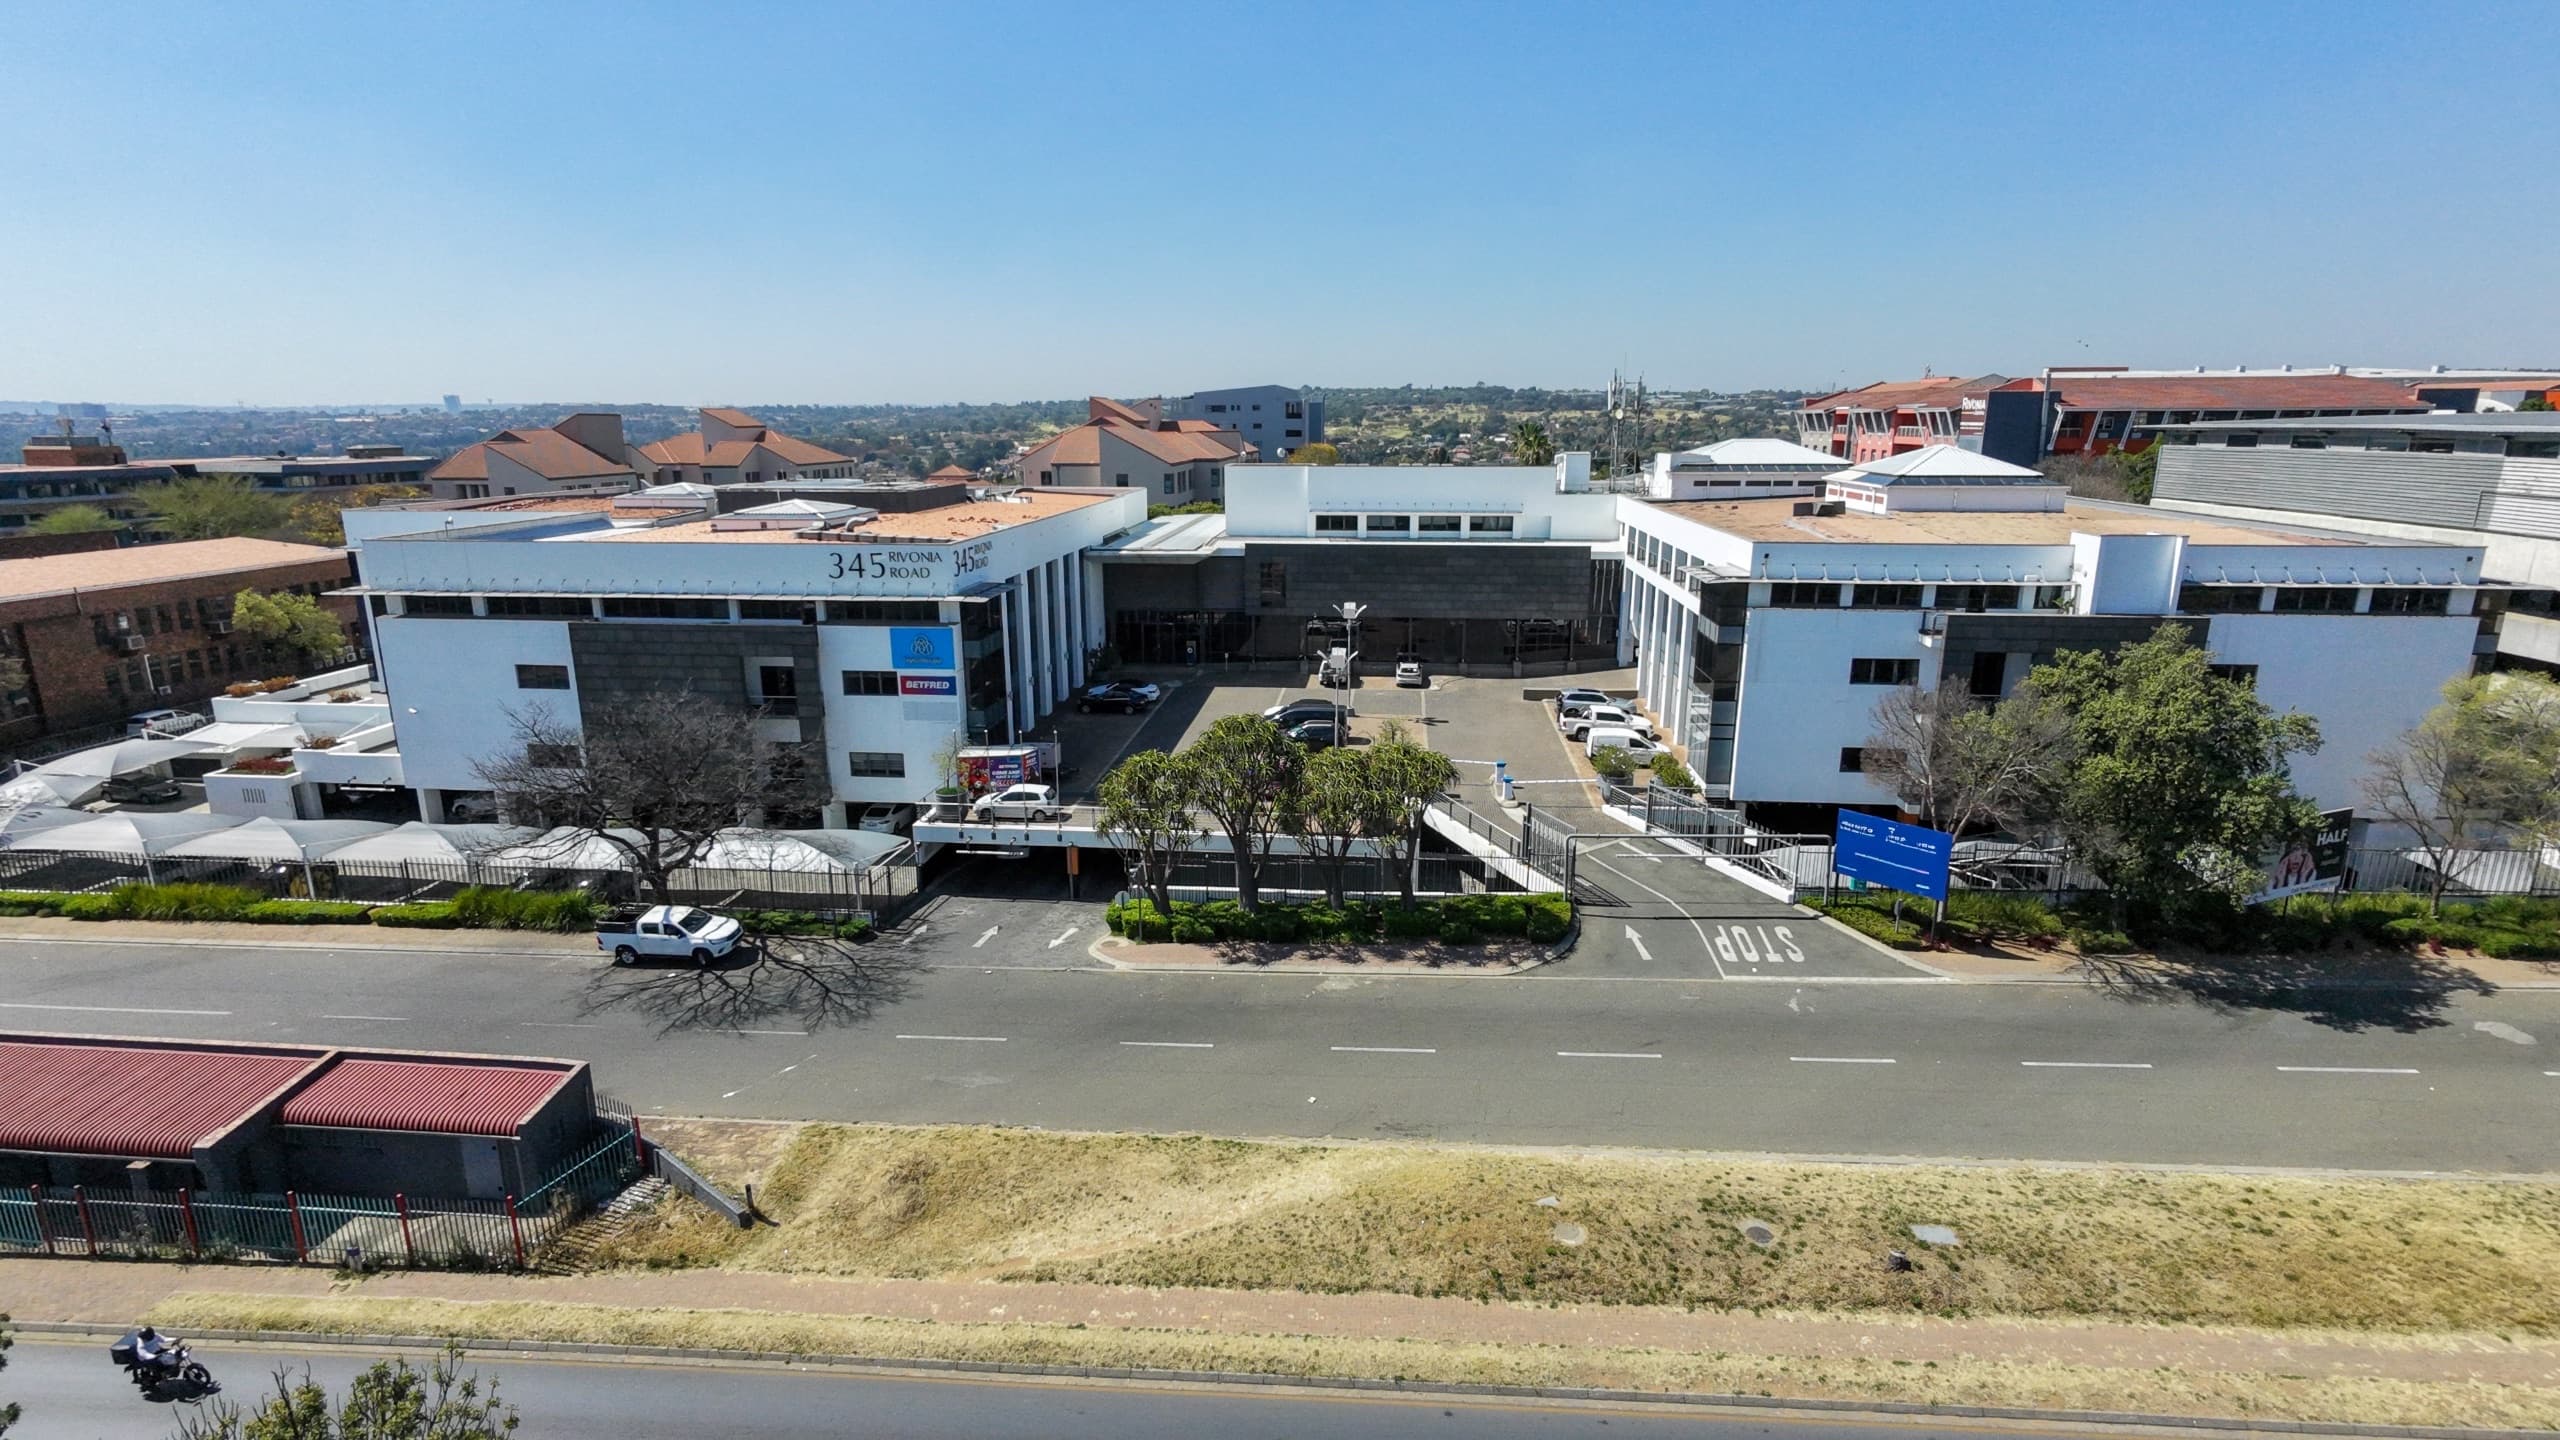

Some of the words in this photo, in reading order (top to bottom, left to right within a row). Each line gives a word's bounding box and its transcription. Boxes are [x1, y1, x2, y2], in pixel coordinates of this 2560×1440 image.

[828, 552, 885, 579] 345
[888, 551, 943, 563] RIVONIA
[889, 567, 930, 579] ROAD
[953, 546, 975, 577] 345
[905, 680, 950, 689] BETFRED
[2316, 828, 2348, 846] HALF
[1714, 925, 1805, 962] STOP
